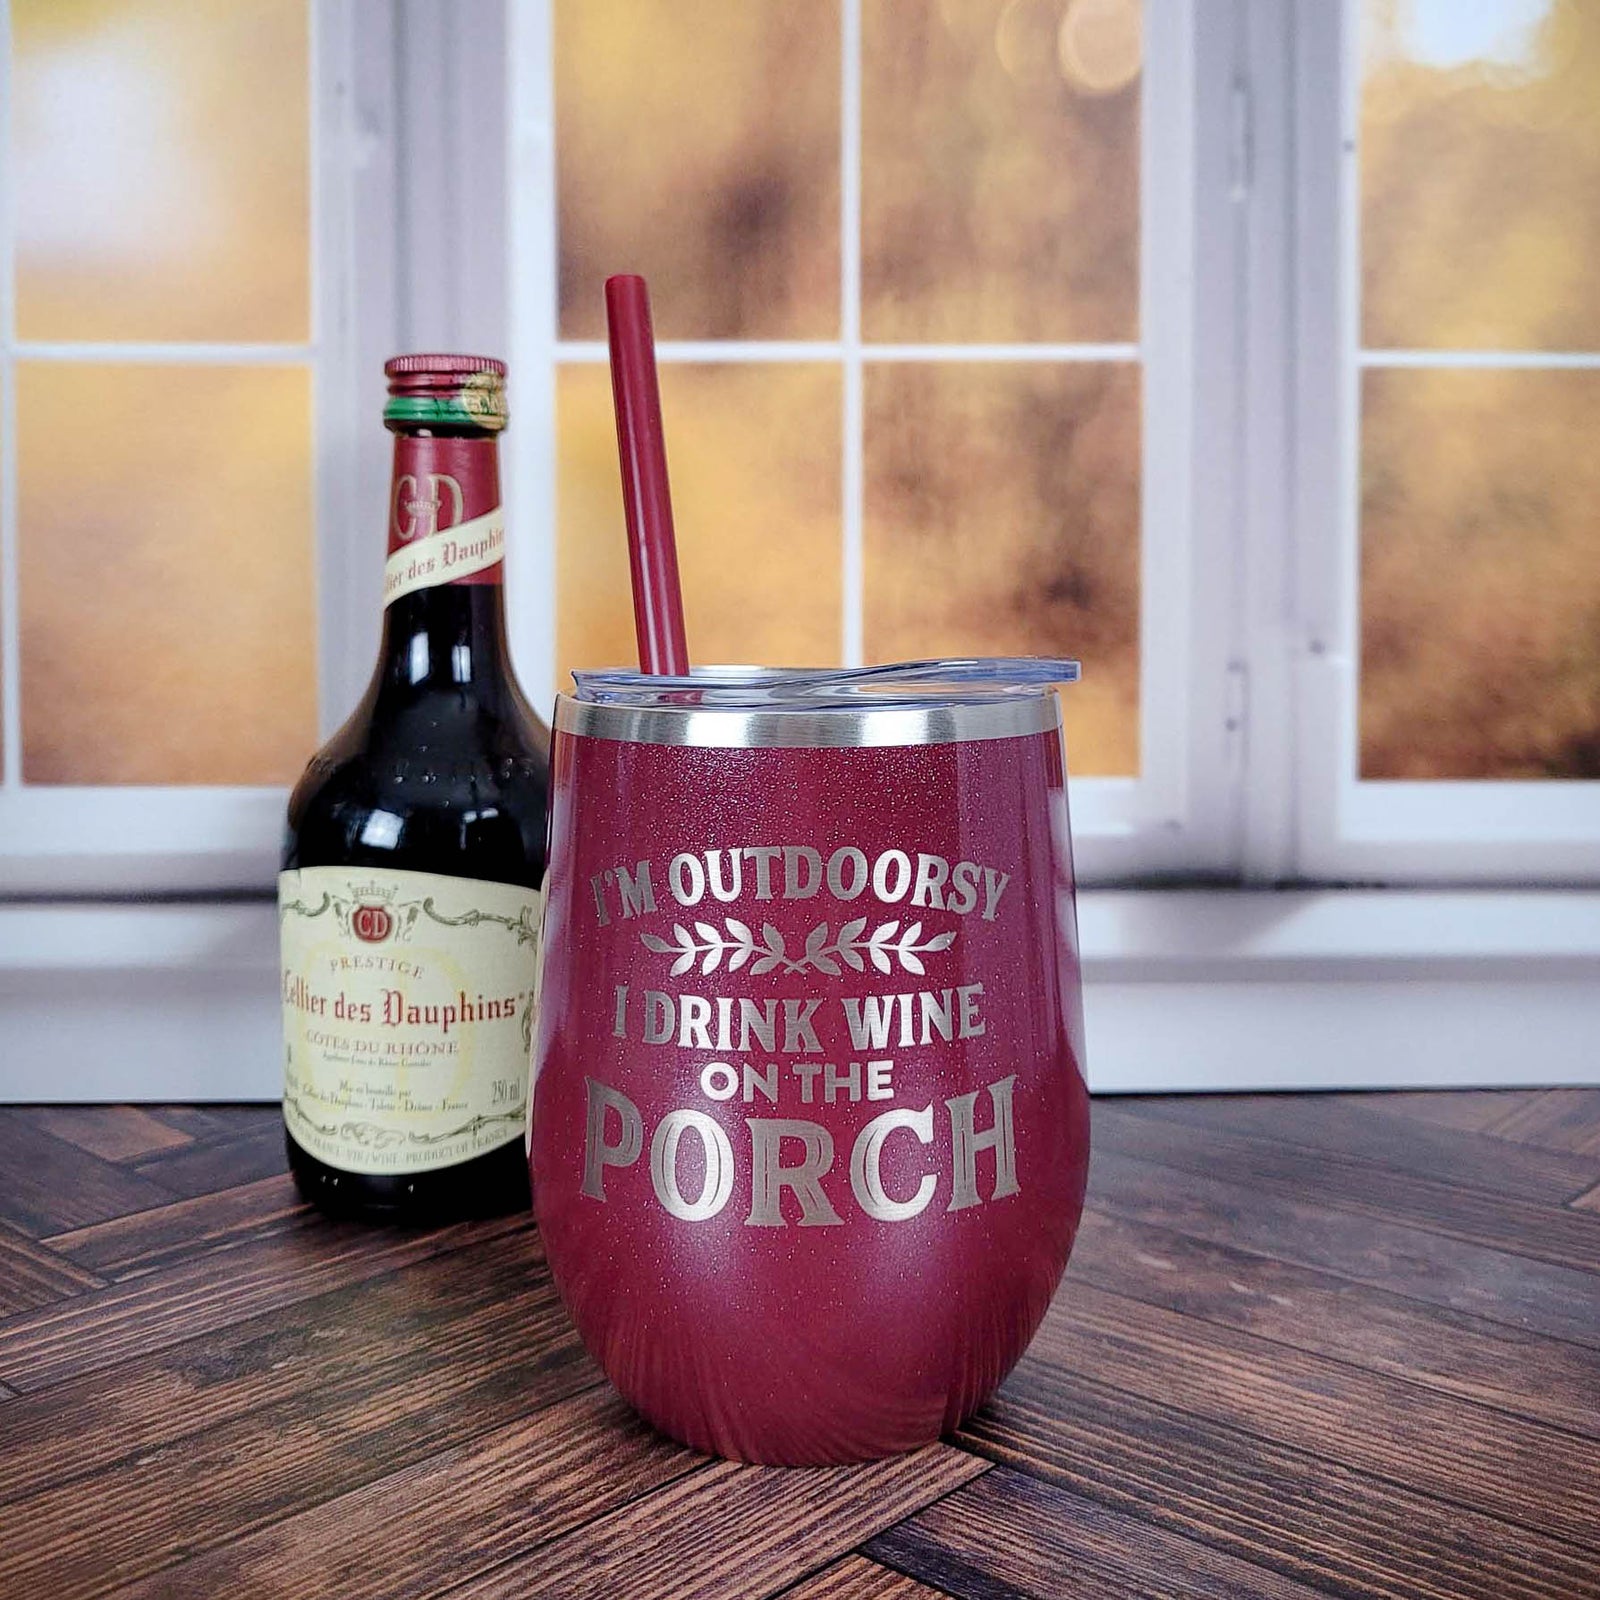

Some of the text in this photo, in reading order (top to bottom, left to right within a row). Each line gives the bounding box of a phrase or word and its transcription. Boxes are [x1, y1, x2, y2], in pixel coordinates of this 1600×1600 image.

[408, 558, 435, 580] des
[590, 846, 1011, 927] I'M OUTDOORSY
[357, 911, 388, 937] CD
[330, 955, 425, 979] PRESTIGE
[335, 991, 372, 1022] des
[382, 989, 516, 1033] Dauphins
[612, 983, 987, 1053] I DRINK WINE
[354, 1040, 380, 1053] DU
[700, 1060, 895, 1103] ON THE
[579, 1074, 1022, 1227] PORCH
